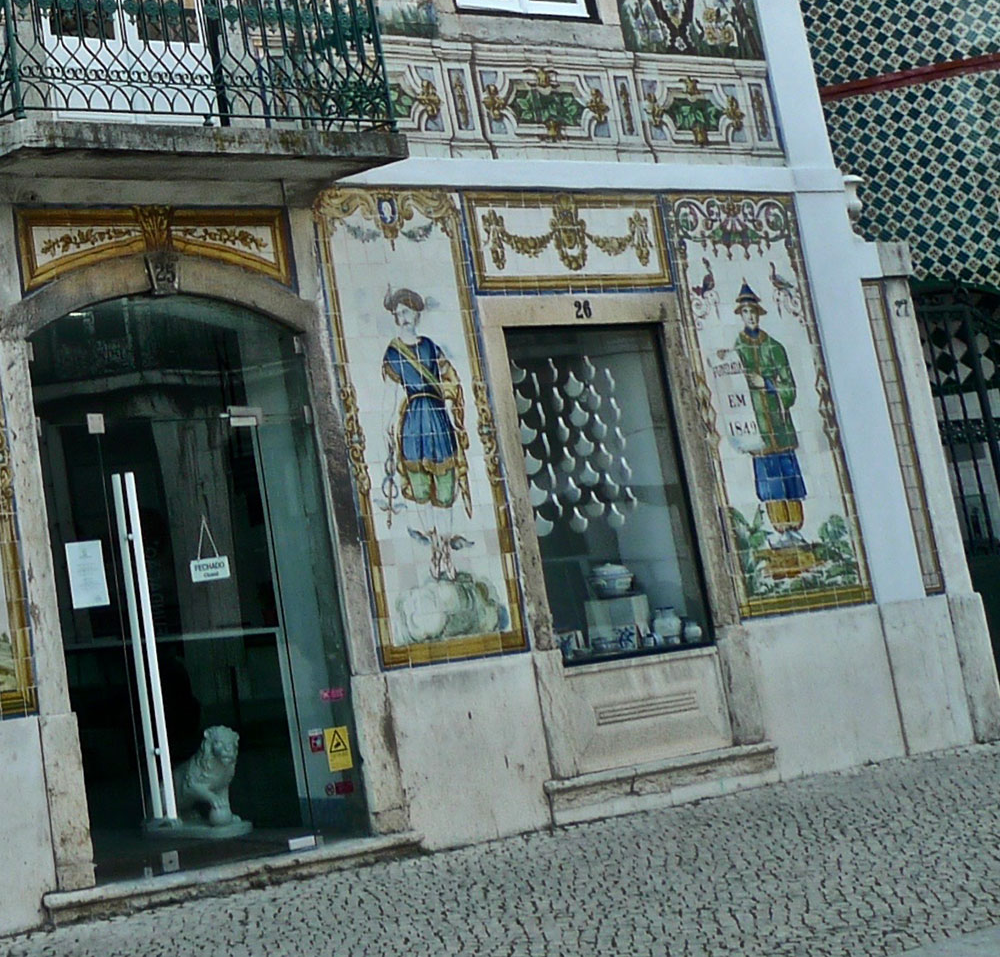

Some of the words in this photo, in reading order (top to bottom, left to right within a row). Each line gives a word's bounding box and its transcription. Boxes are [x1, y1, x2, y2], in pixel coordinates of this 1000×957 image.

[155, 262, 176, 283] 25
[574, 300, 592, 319] 26
[728, 394, 747, 408] EM
[729, 420, 758, 437] 1849
